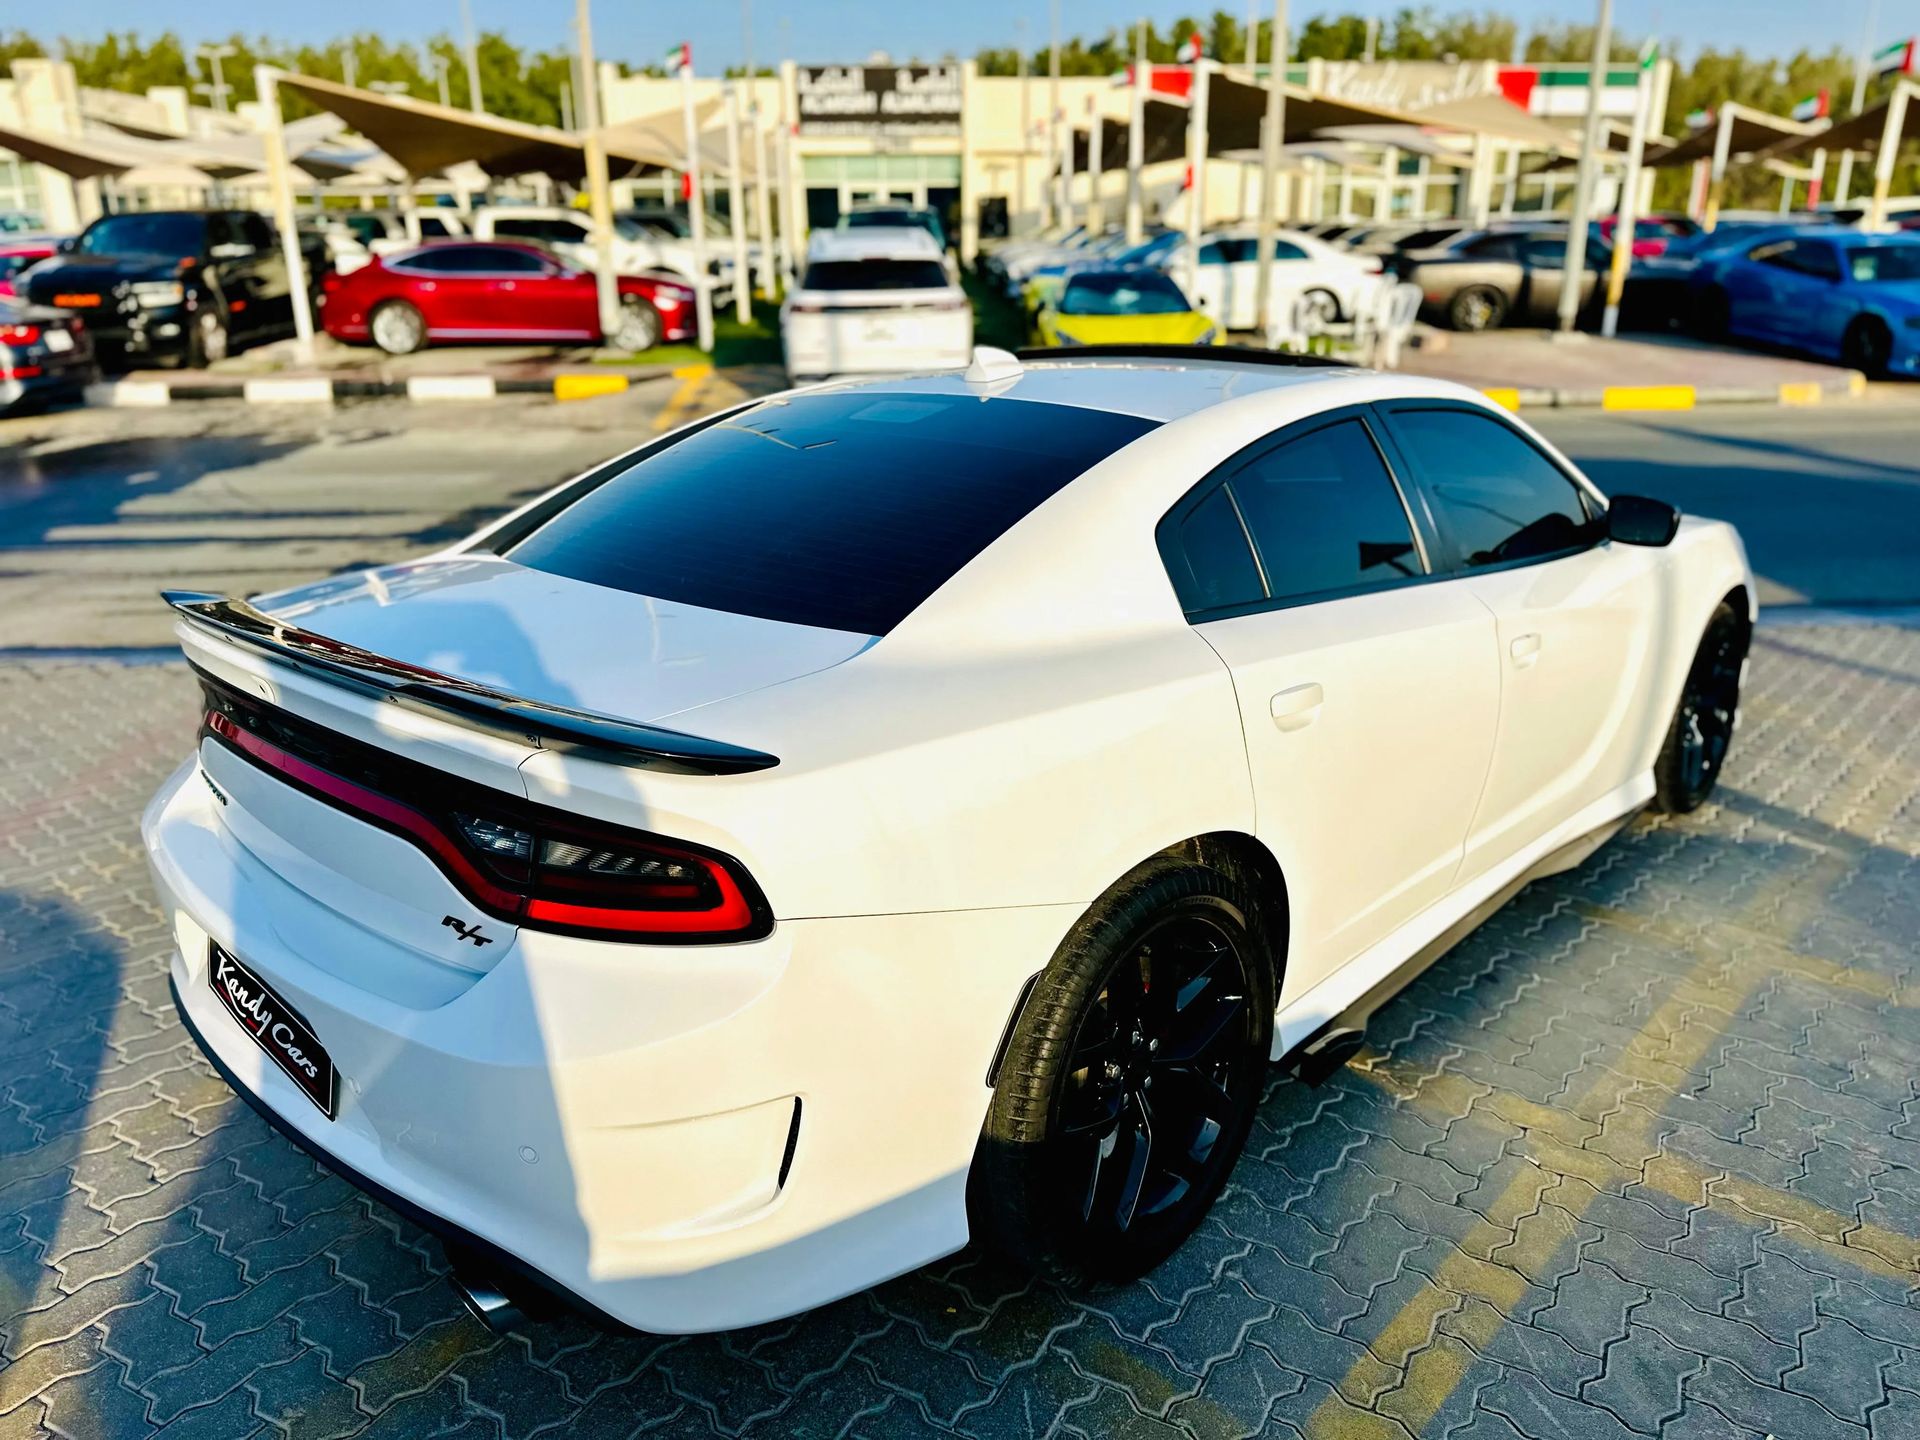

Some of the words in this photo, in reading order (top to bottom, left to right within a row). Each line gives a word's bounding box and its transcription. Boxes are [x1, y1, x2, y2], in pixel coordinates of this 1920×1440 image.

[441, 915, 494, 947] R/T
[217, 950, 273, 1037] Kandy
[271, 1022, 319, 1079] Cars
